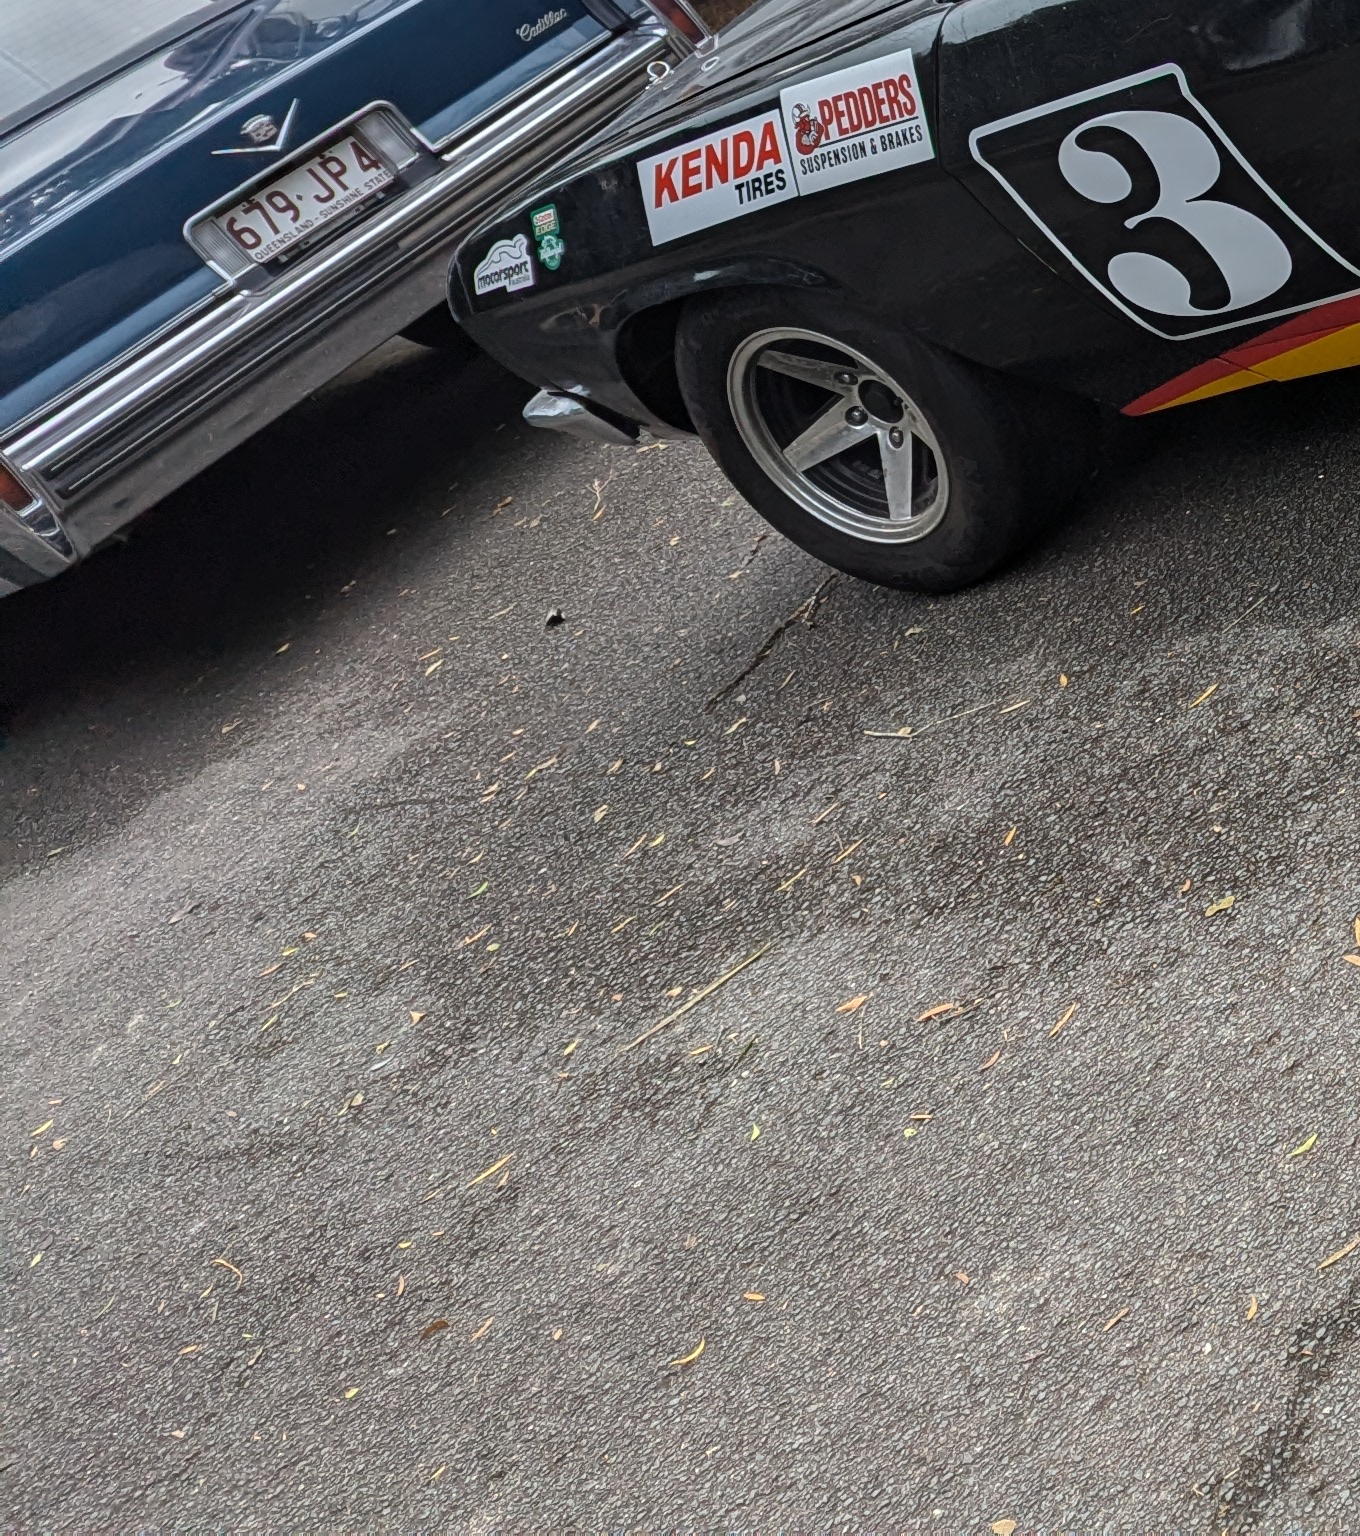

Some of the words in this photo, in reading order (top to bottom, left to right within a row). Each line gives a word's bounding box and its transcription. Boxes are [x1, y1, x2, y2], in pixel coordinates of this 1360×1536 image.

[516, 8, 567, 41] Cadillac
[818, 73, 916, 140] PEDDERS
[654, 120, 782, 209] KENDA
[800, 140, 867, 175] SUSPENSION
[870, 137, 878, 155] &
[881, 124, 923, 152] BRAKES
[254, 219, 315, 261] QUEENSLAND
[319, 188, 364, 220] SUNSHINE
[363, 170, 393, 192] STATE
[735, 168, 786, 205] TIRES
[1057, 109, 1293, 316] 3
